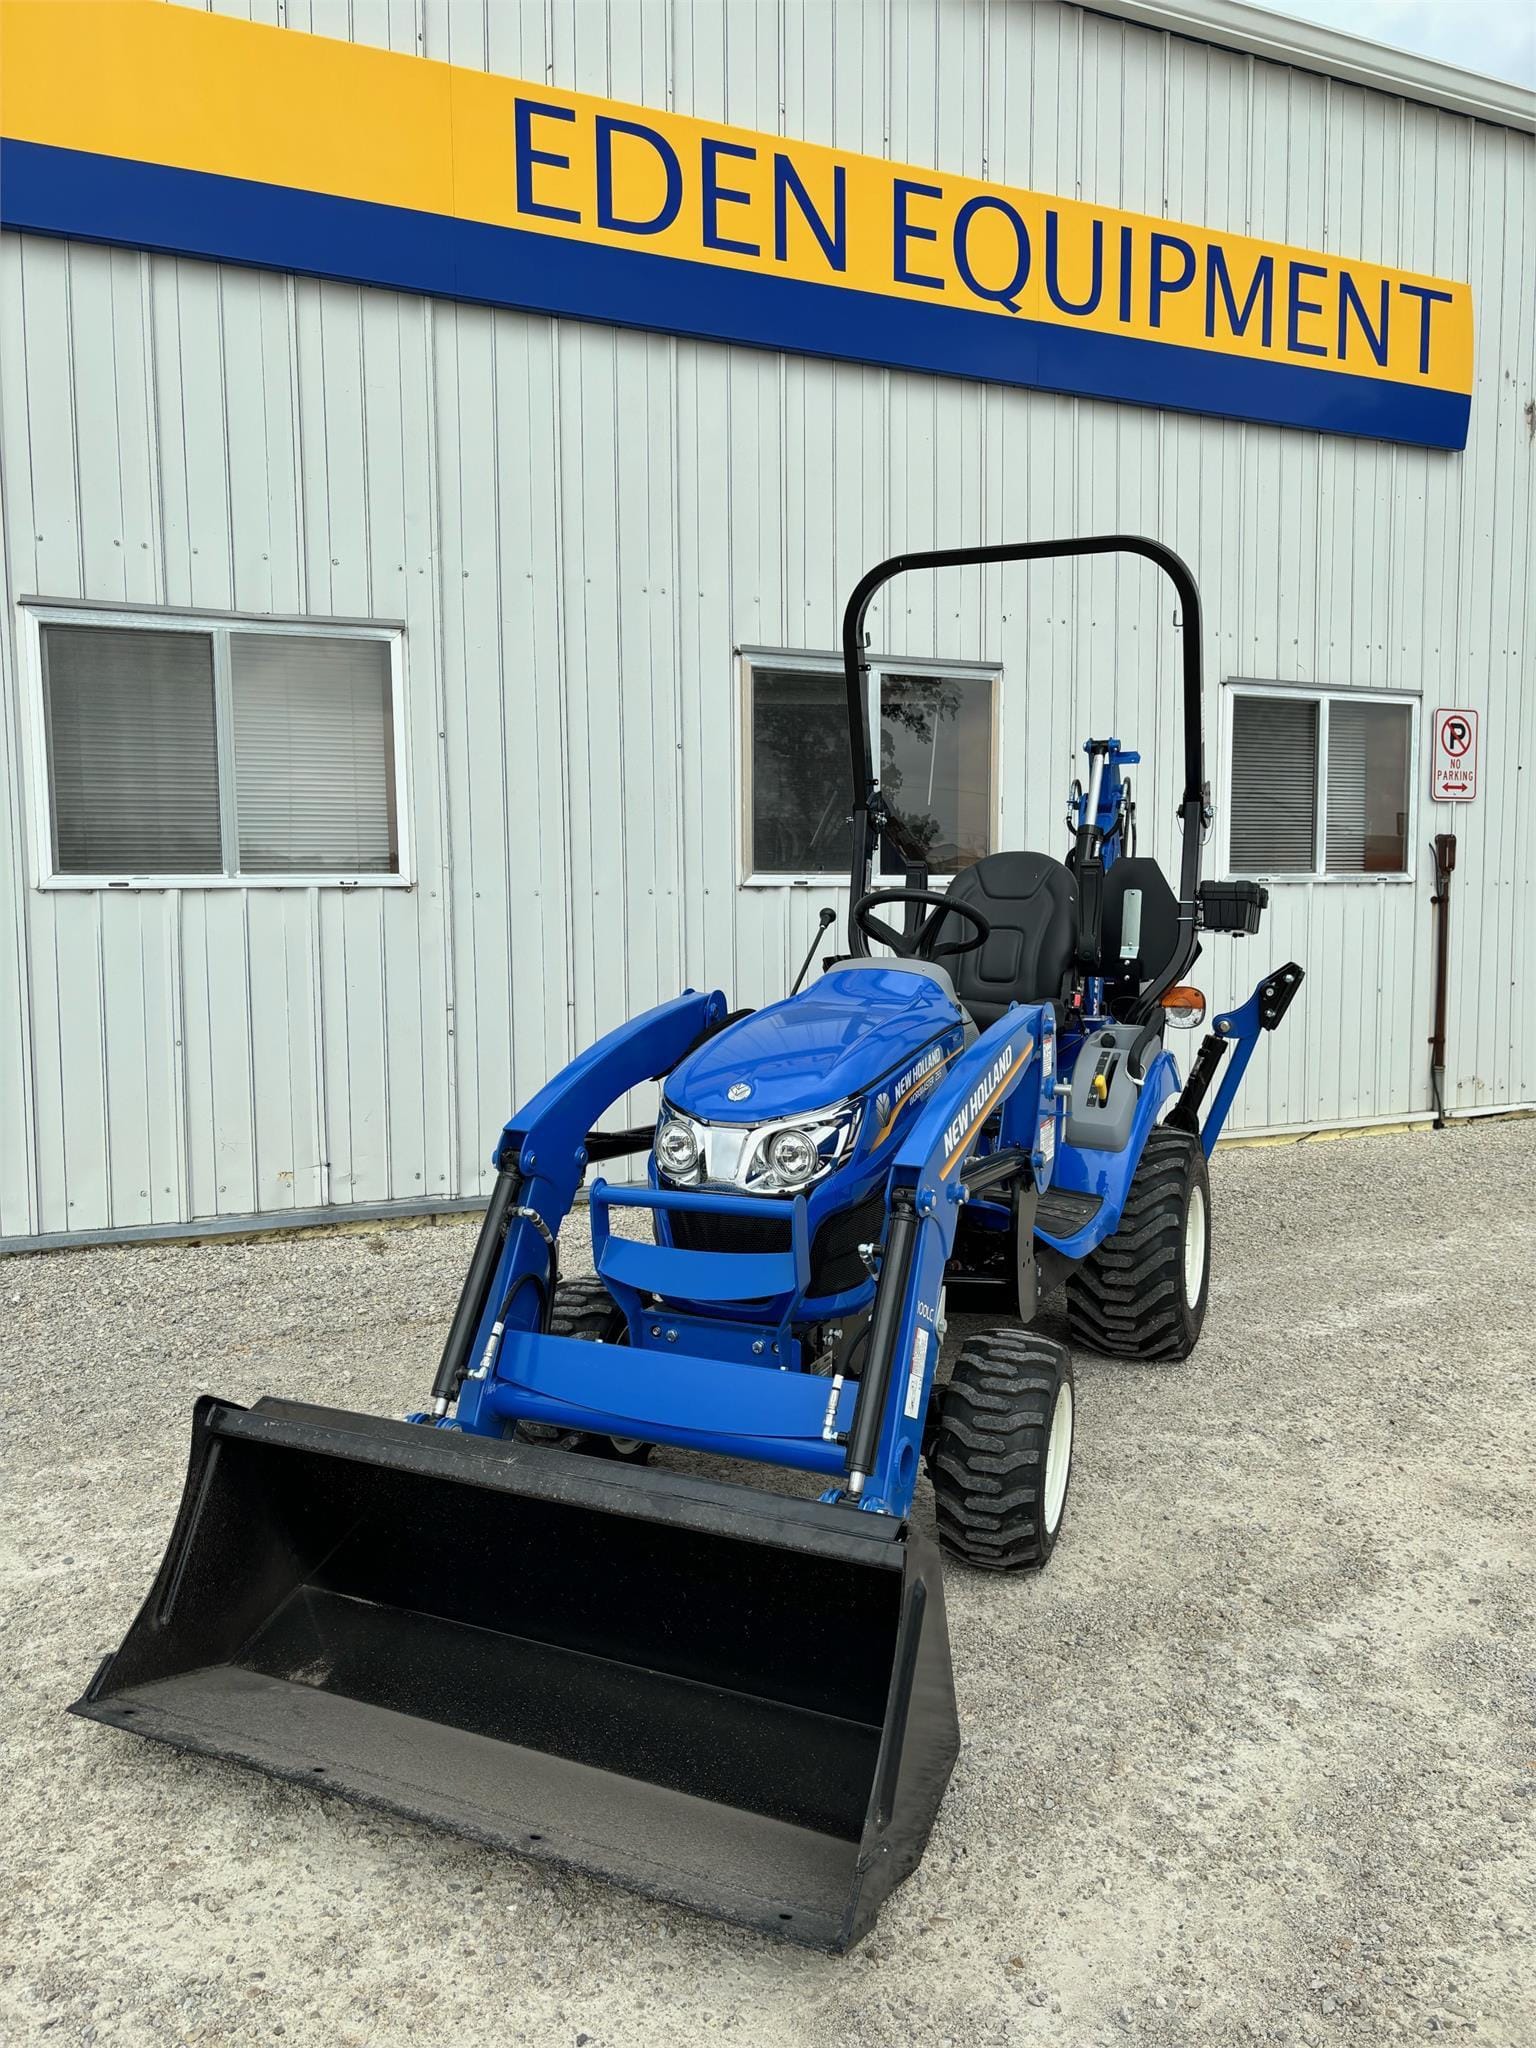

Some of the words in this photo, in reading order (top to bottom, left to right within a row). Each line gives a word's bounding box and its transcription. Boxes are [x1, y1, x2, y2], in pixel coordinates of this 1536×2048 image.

[515, 98, 846, 272] EDEN
[893, 178, 1453, 374] EQUIPMENT
[1437, 770, 1473, 781] PARKING
[1450, 759, 1461, 769] NO
[894, 1070, 912, 1102] NEW
[912, 1047, 941, 1083] HOLLAND
[944, 1104, 969, 1158] NEW
[970, 1045, 1012, 1122] HOLLAND
[917, 1300, 934, 1322] 100LC
